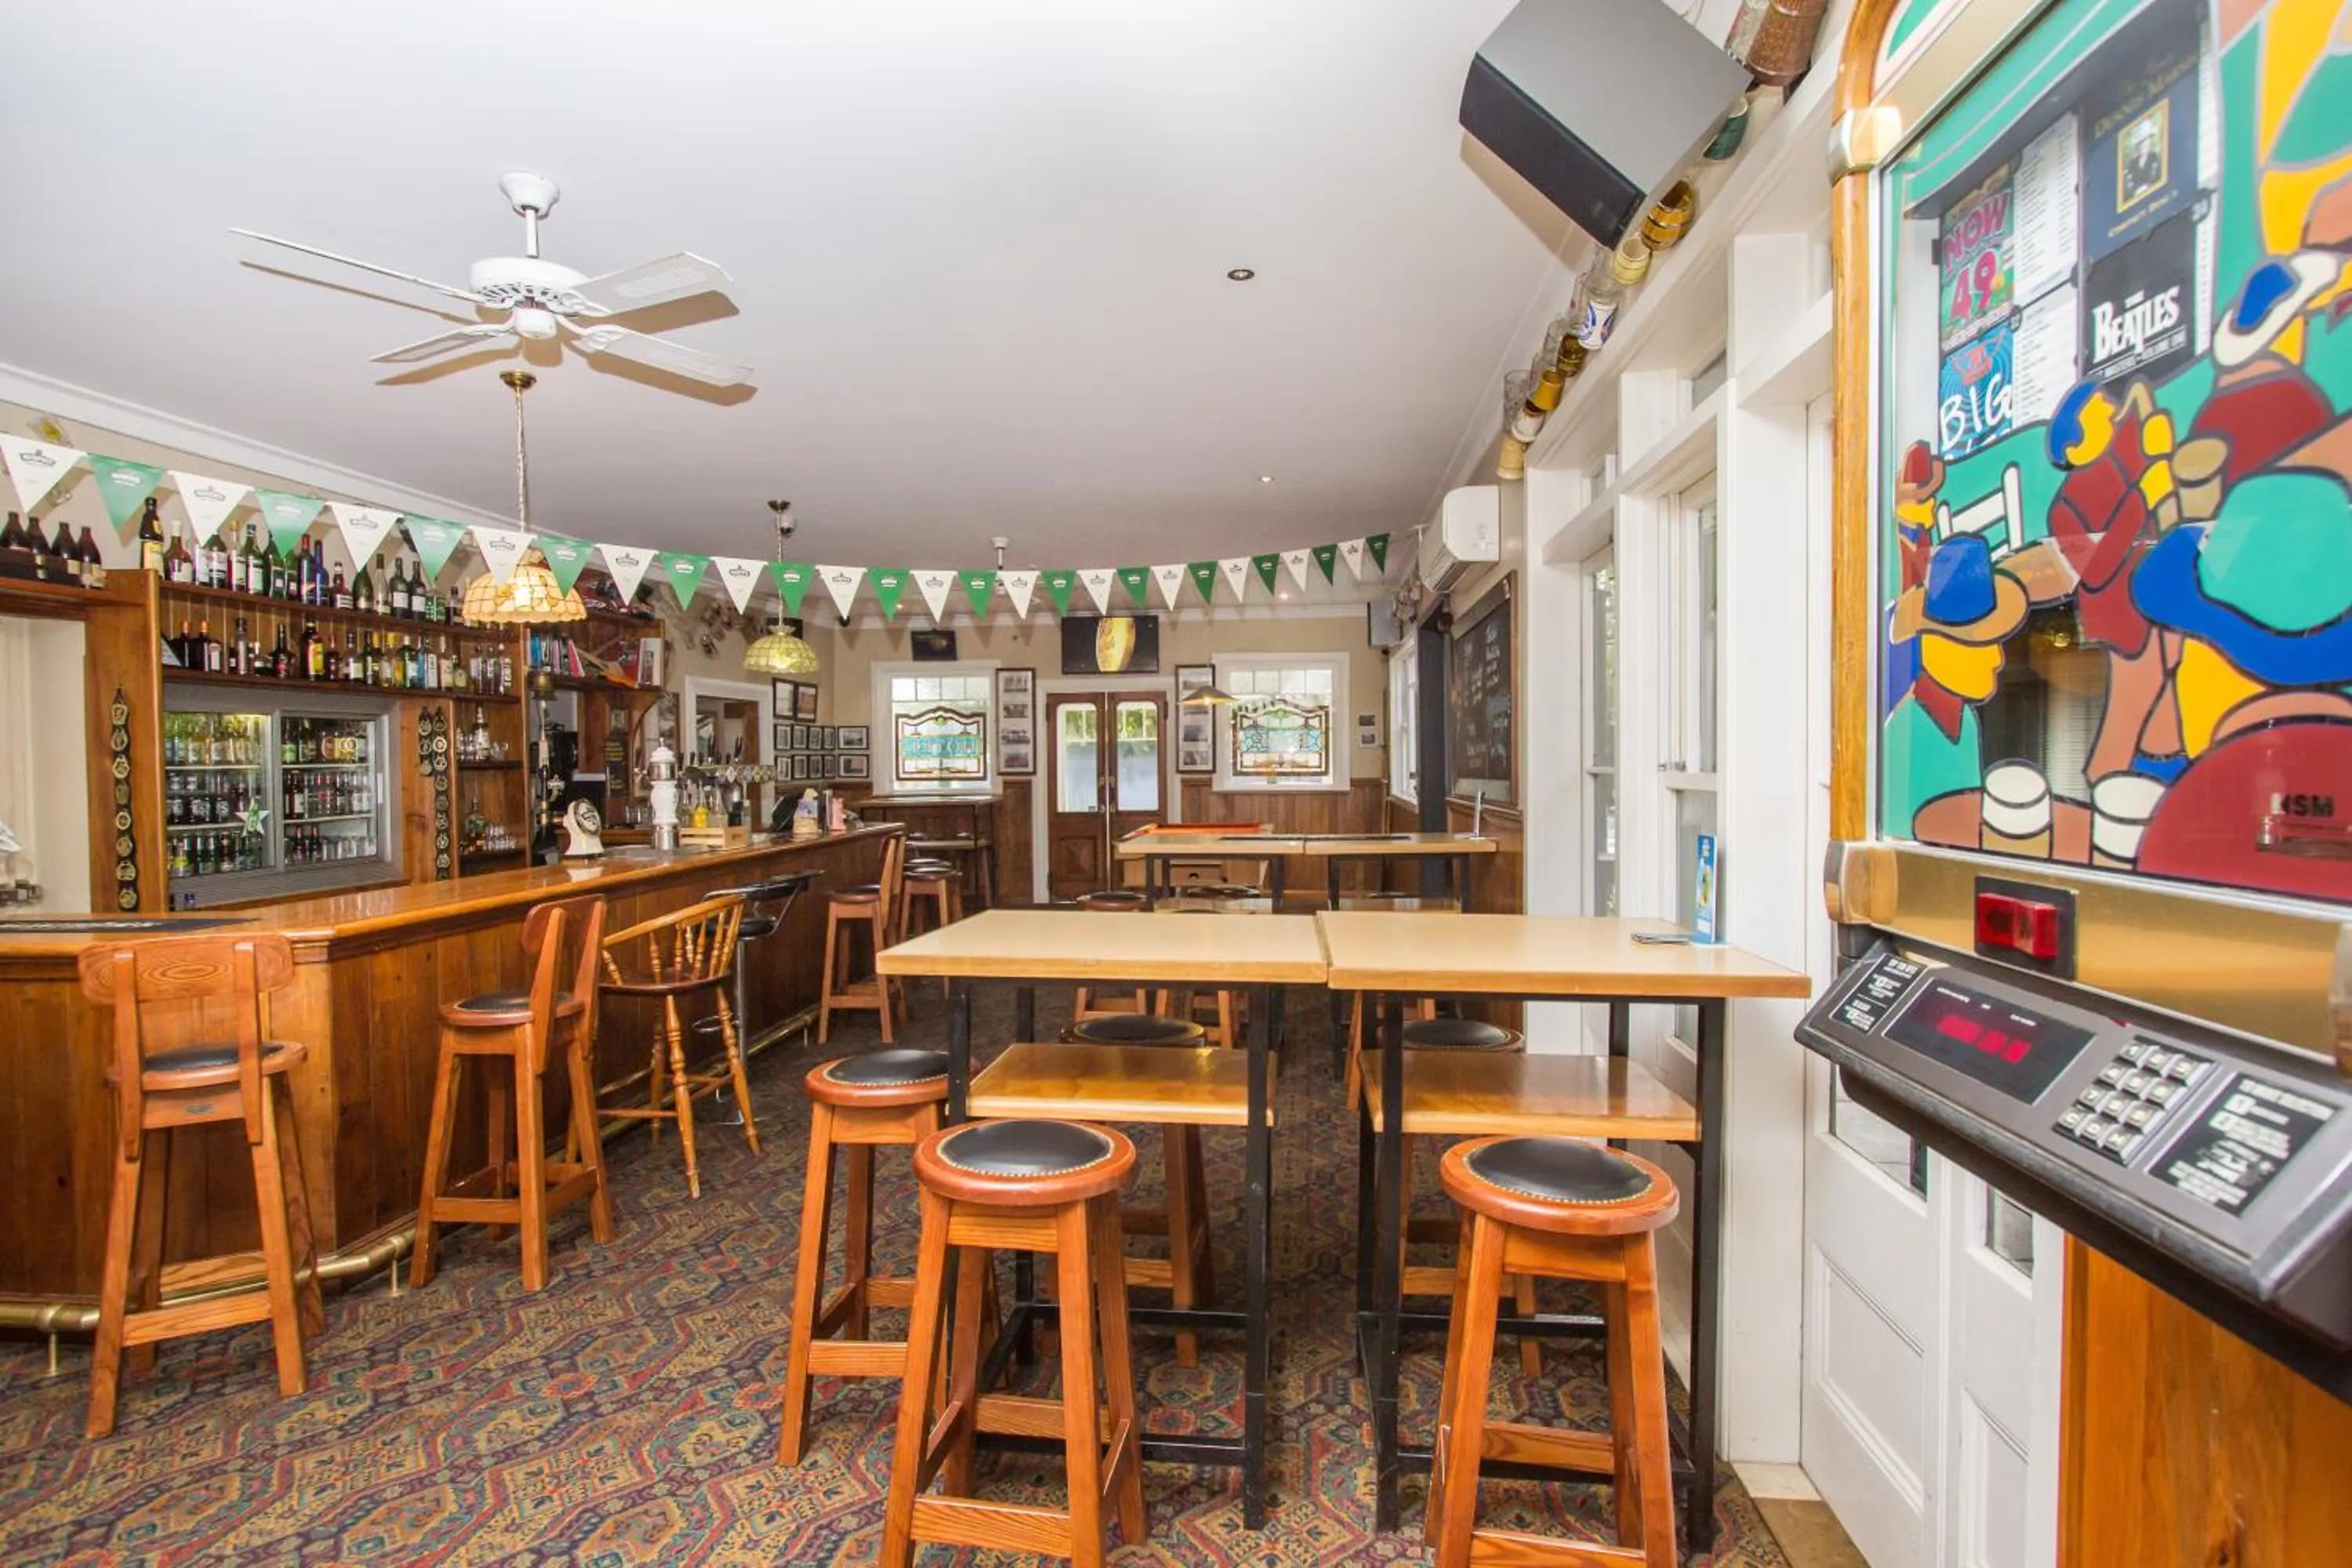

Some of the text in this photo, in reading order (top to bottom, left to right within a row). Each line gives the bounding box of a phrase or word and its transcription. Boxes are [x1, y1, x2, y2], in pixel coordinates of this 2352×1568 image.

[1944, 190, 2010, 269] NOW
[1949, 249, 1998, 320] 49
[2092, 285, 2180, 365] BEATLES
[1940, 373, 2013, 451] BIG
